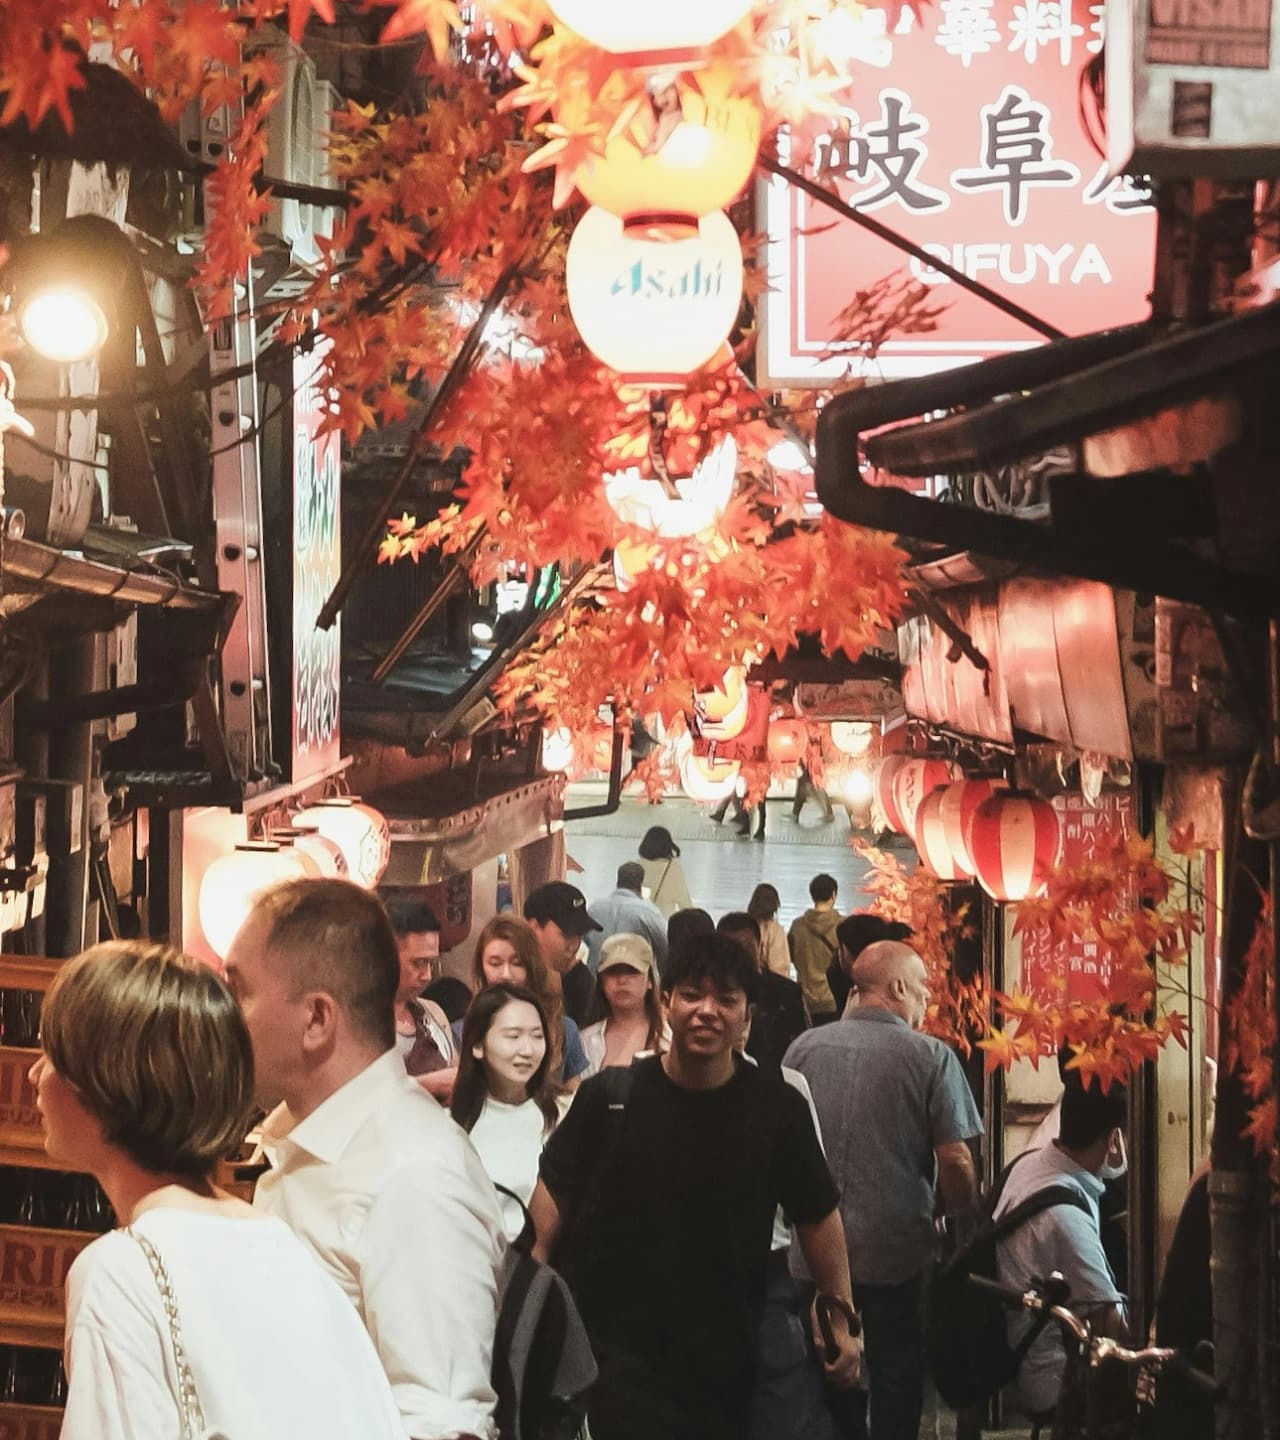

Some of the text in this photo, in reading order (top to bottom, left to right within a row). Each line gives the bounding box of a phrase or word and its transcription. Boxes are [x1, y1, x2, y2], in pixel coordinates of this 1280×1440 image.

[815, 87, 1158, 225] 岐阜
[609, 254, 723, 302] Asahi
[910, 242, 1113, 285] GIFUYA
